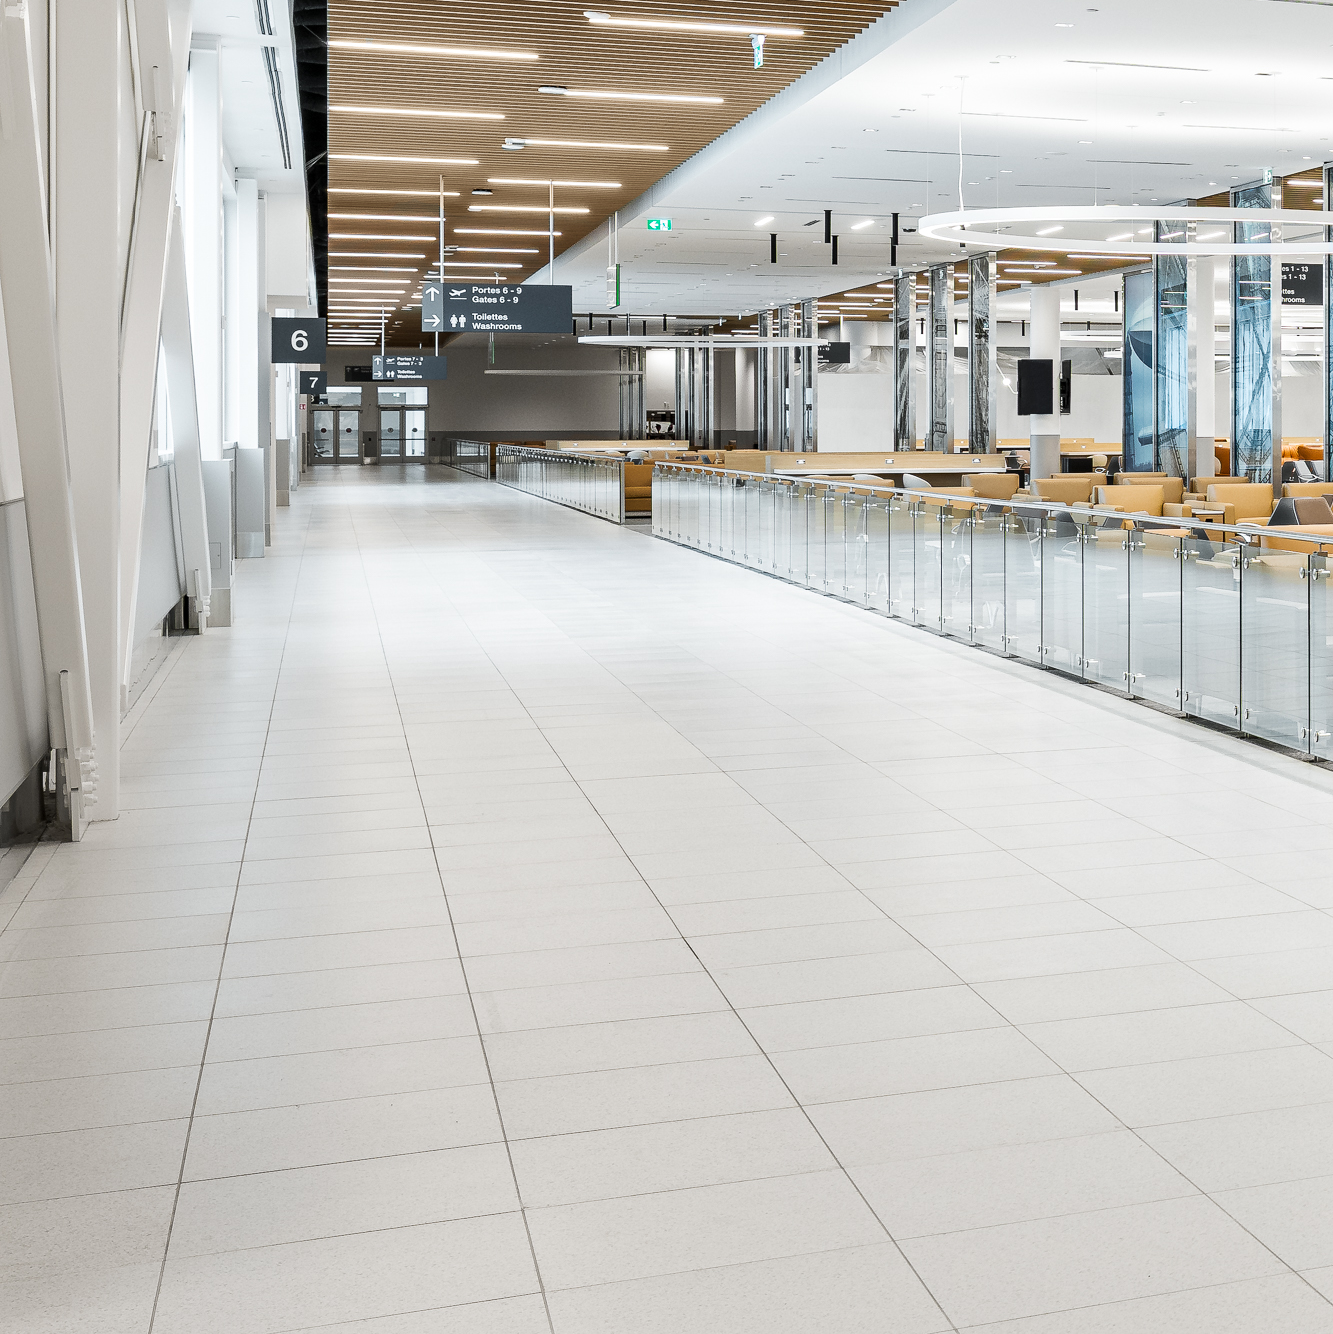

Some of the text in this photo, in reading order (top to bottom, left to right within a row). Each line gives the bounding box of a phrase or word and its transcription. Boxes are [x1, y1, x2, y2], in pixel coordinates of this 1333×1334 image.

[472, 286, 500, 294] Portes
[472, 322, 522, 330] Washrooms
[291, 329, 309, 351] 6
[309, 377, 319, 388] 7
